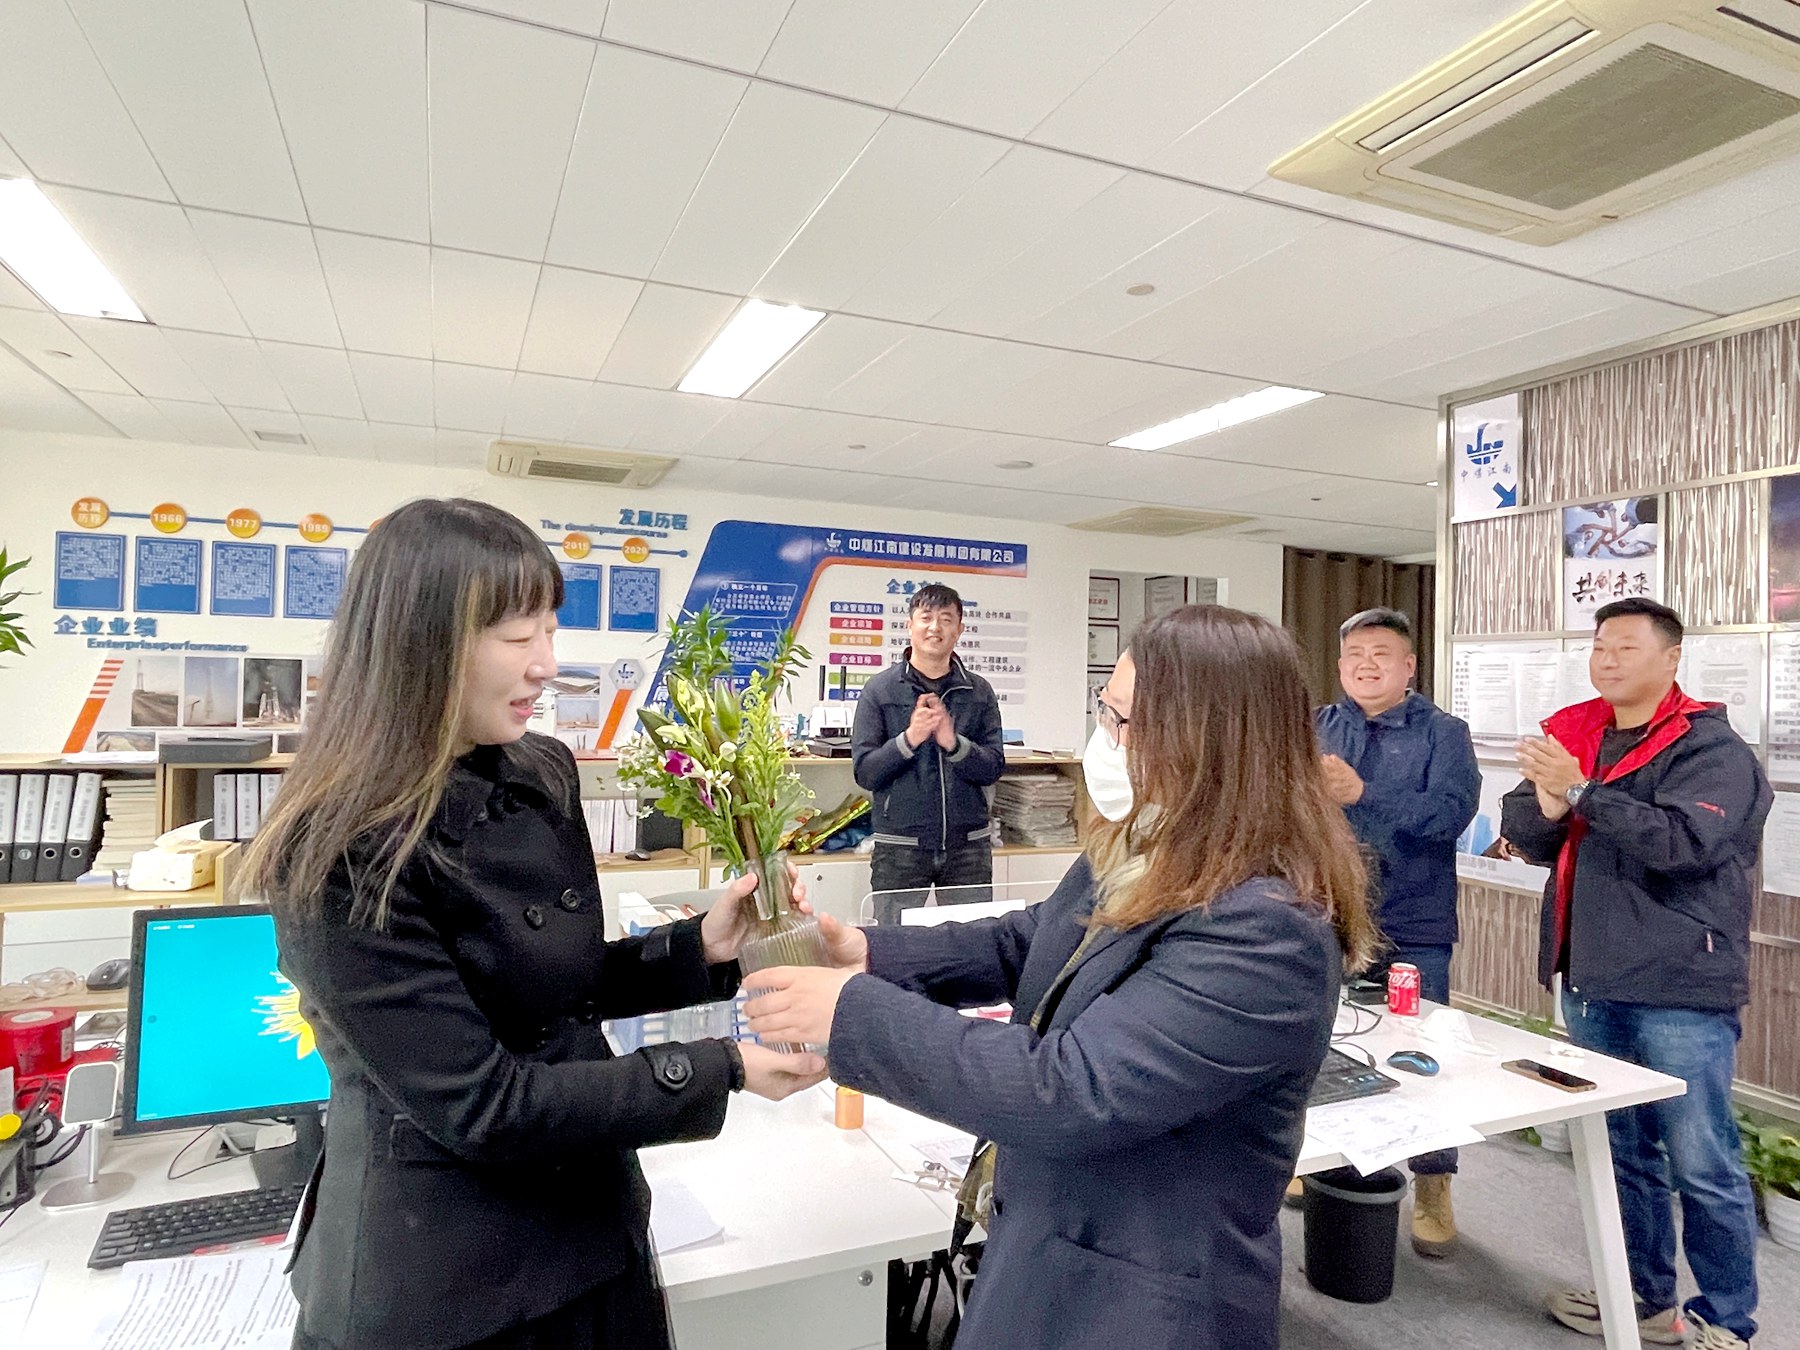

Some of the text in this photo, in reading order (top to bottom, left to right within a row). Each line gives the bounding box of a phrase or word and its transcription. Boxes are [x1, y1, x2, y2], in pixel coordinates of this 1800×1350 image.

[153, 513, 183, 523] 1966
[229, 518, 257, 529] 1977
[619, 508, 688, 530] 发展历程
[848, 537, 1015, 563] 中煤江南建设发展集团有限公司
[1571, 568, 1651, 603] 共创未来
[833, 602, 881, 613] 企业管理方针
[53, 614, 158, 638] 企业业绩
